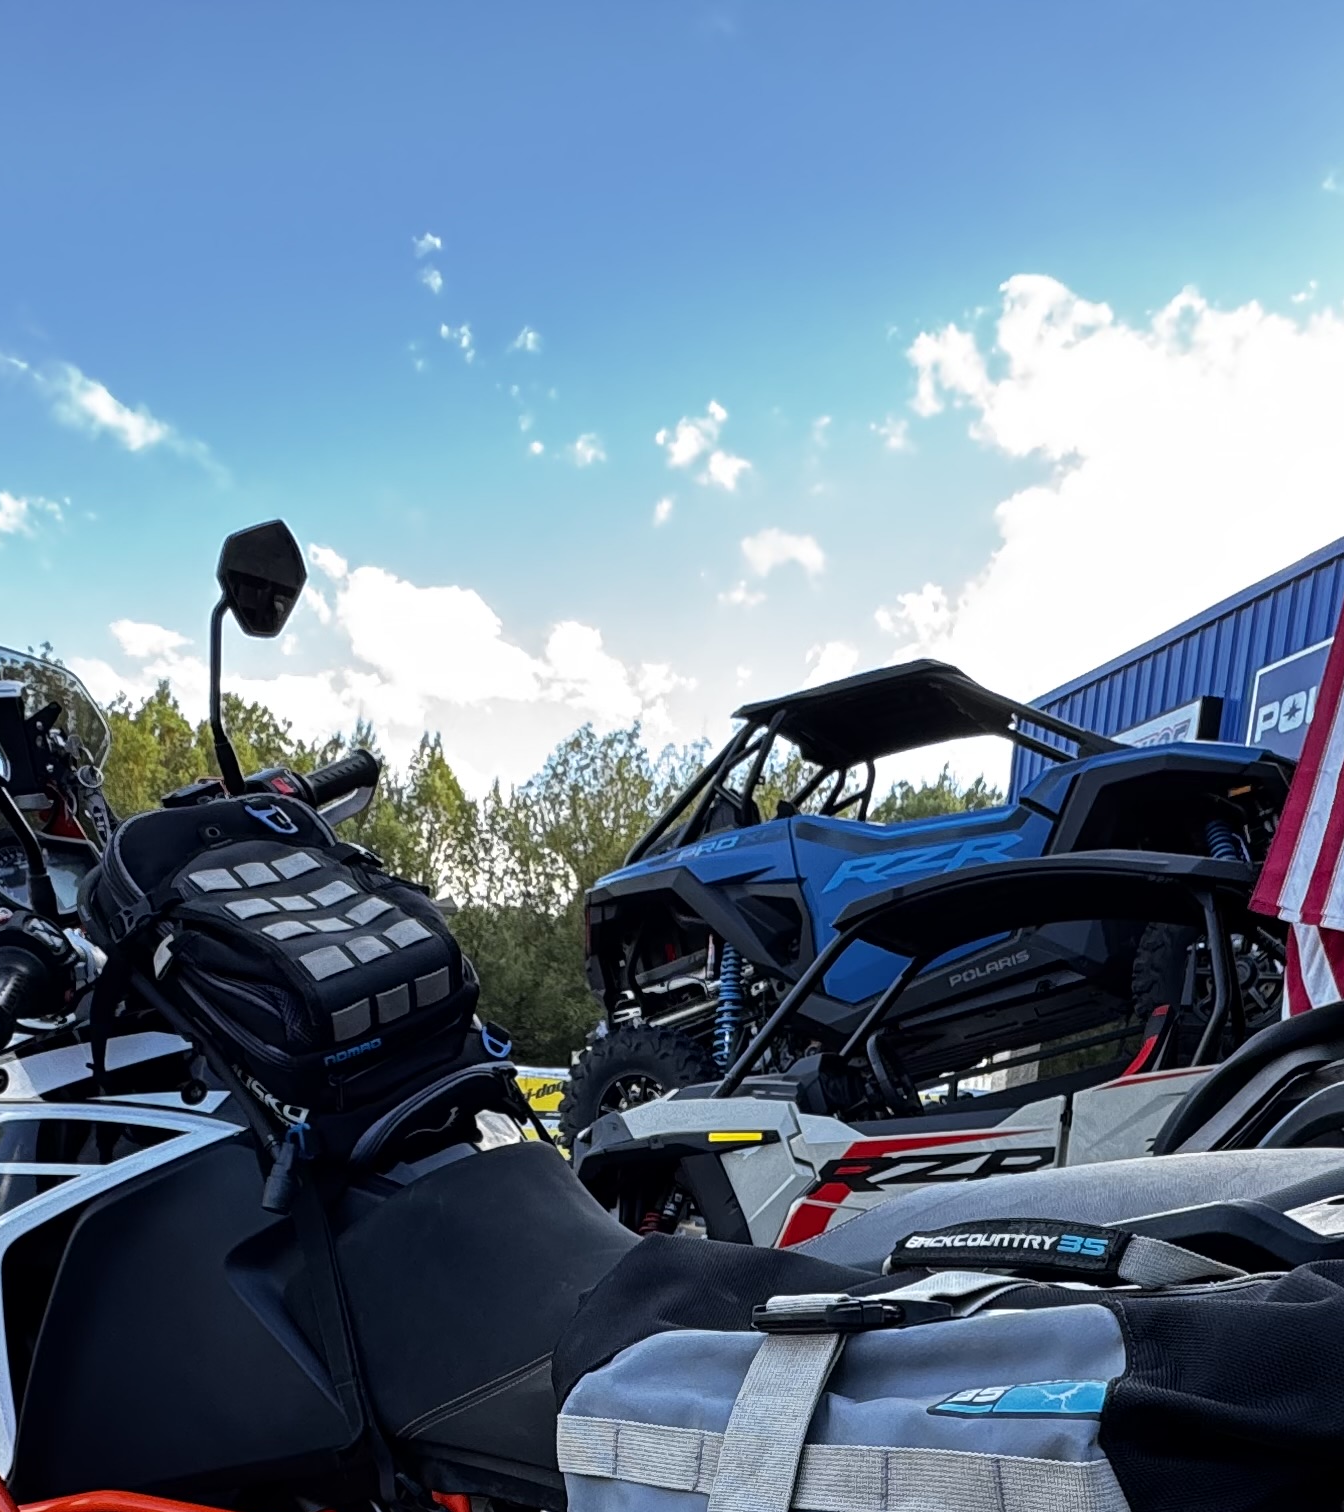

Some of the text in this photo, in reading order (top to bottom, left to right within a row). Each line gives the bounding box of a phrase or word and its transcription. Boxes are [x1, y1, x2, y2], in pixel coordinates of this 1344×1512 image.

[676, 835, 740, 862] PRO
[821, 833, 1024, 894] RZR
[948, 949, 1030, 988] POLARIS
[905, 1233, 1109, 1256] BACKCOUNTRY 35
